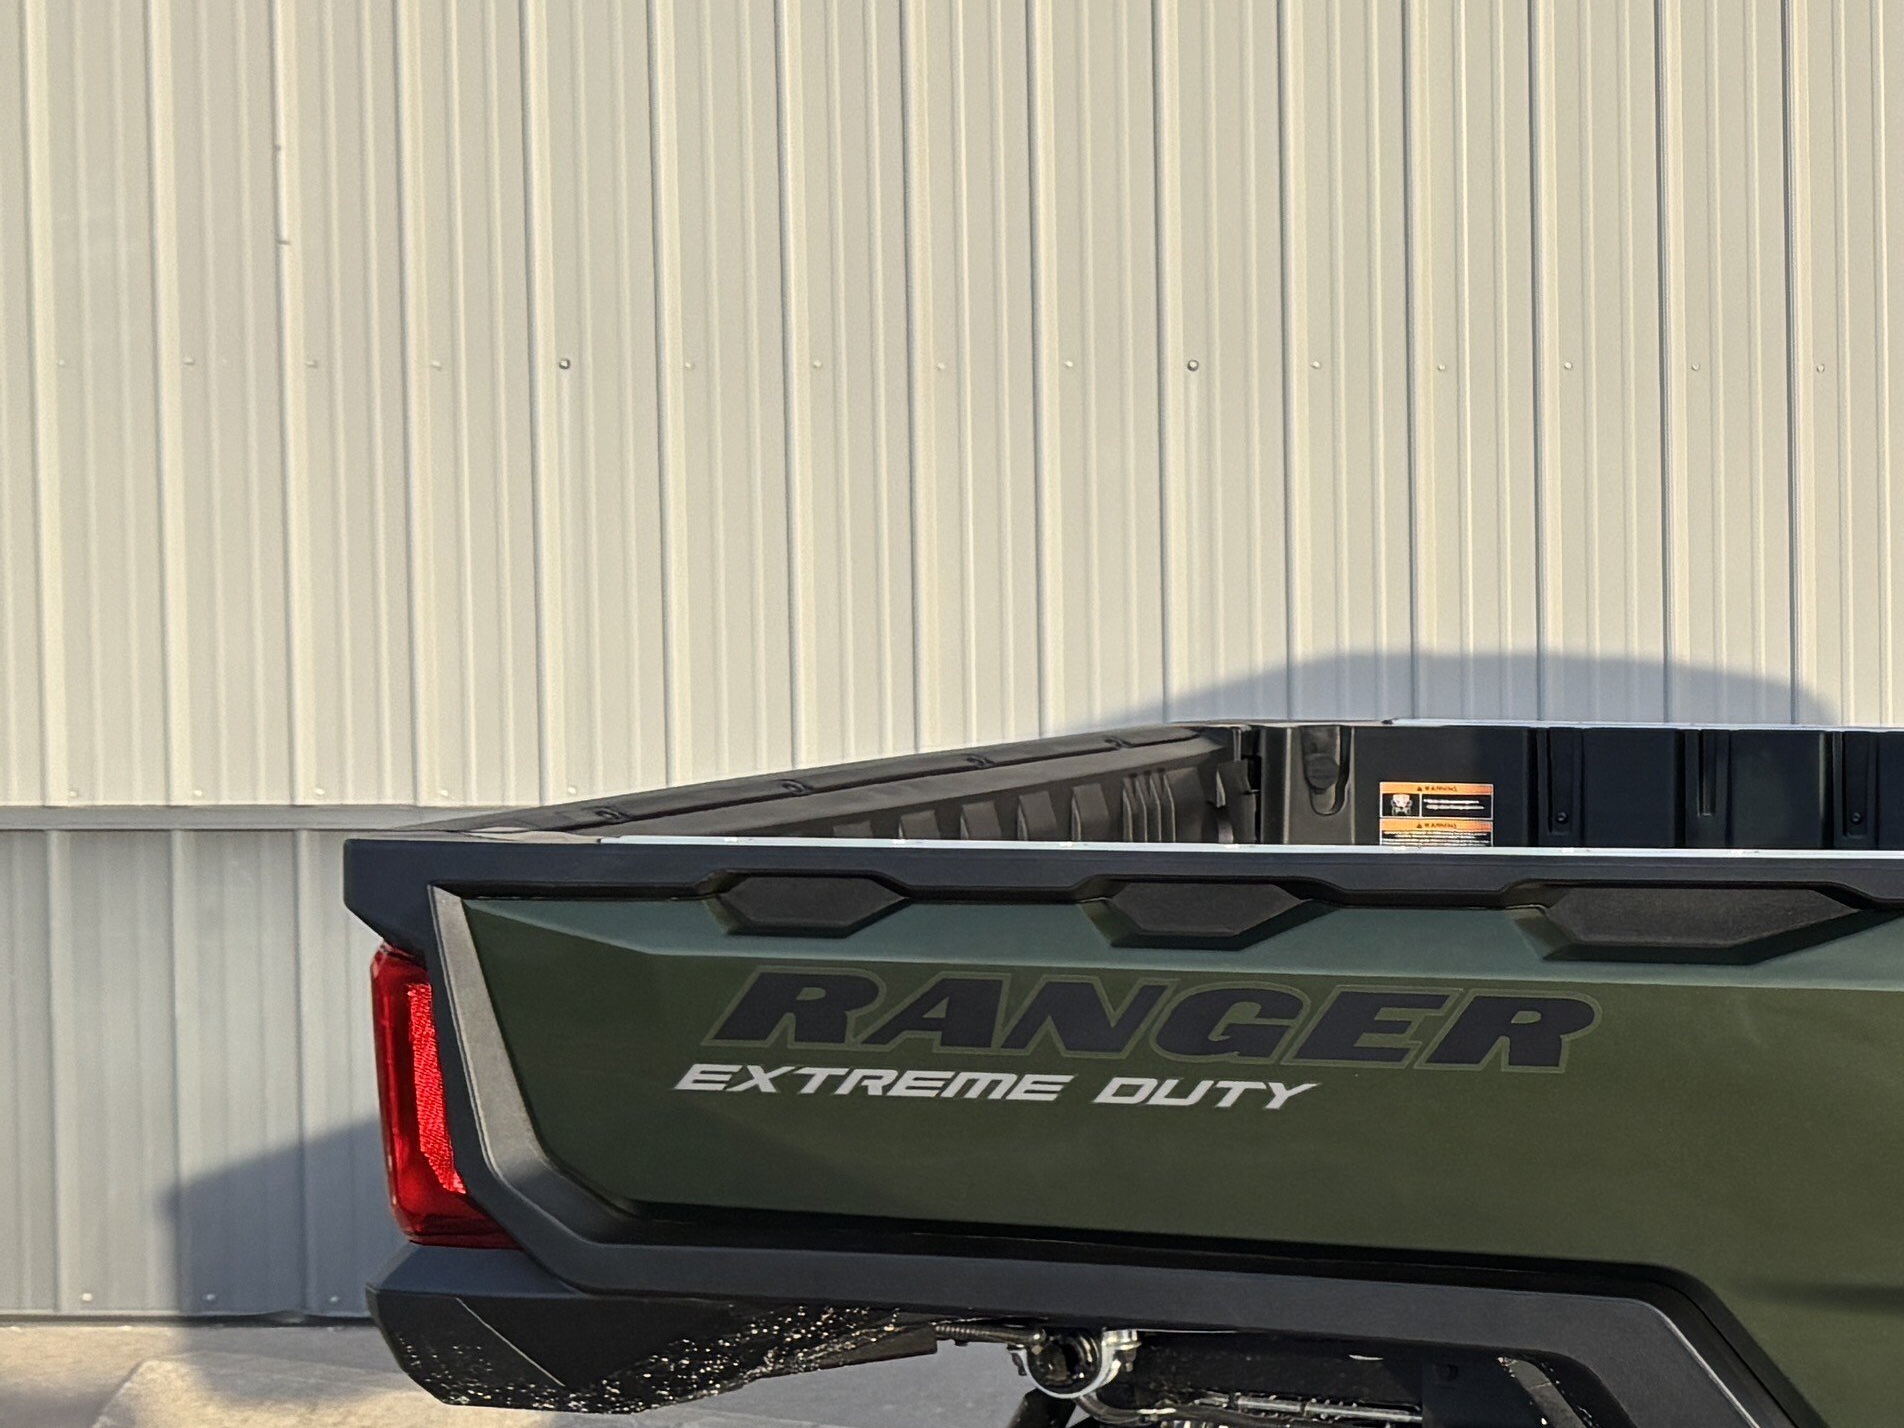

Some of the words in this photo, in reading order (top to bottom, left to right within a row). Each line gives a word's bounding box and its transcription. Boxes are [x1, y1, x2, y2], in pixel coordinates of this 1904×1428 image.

[702, 965, 1600, 1074] RANGER
[673, 1063, 1076, 1103] EXTREME
[1091, 1075, 1319, 1111] DUTY
